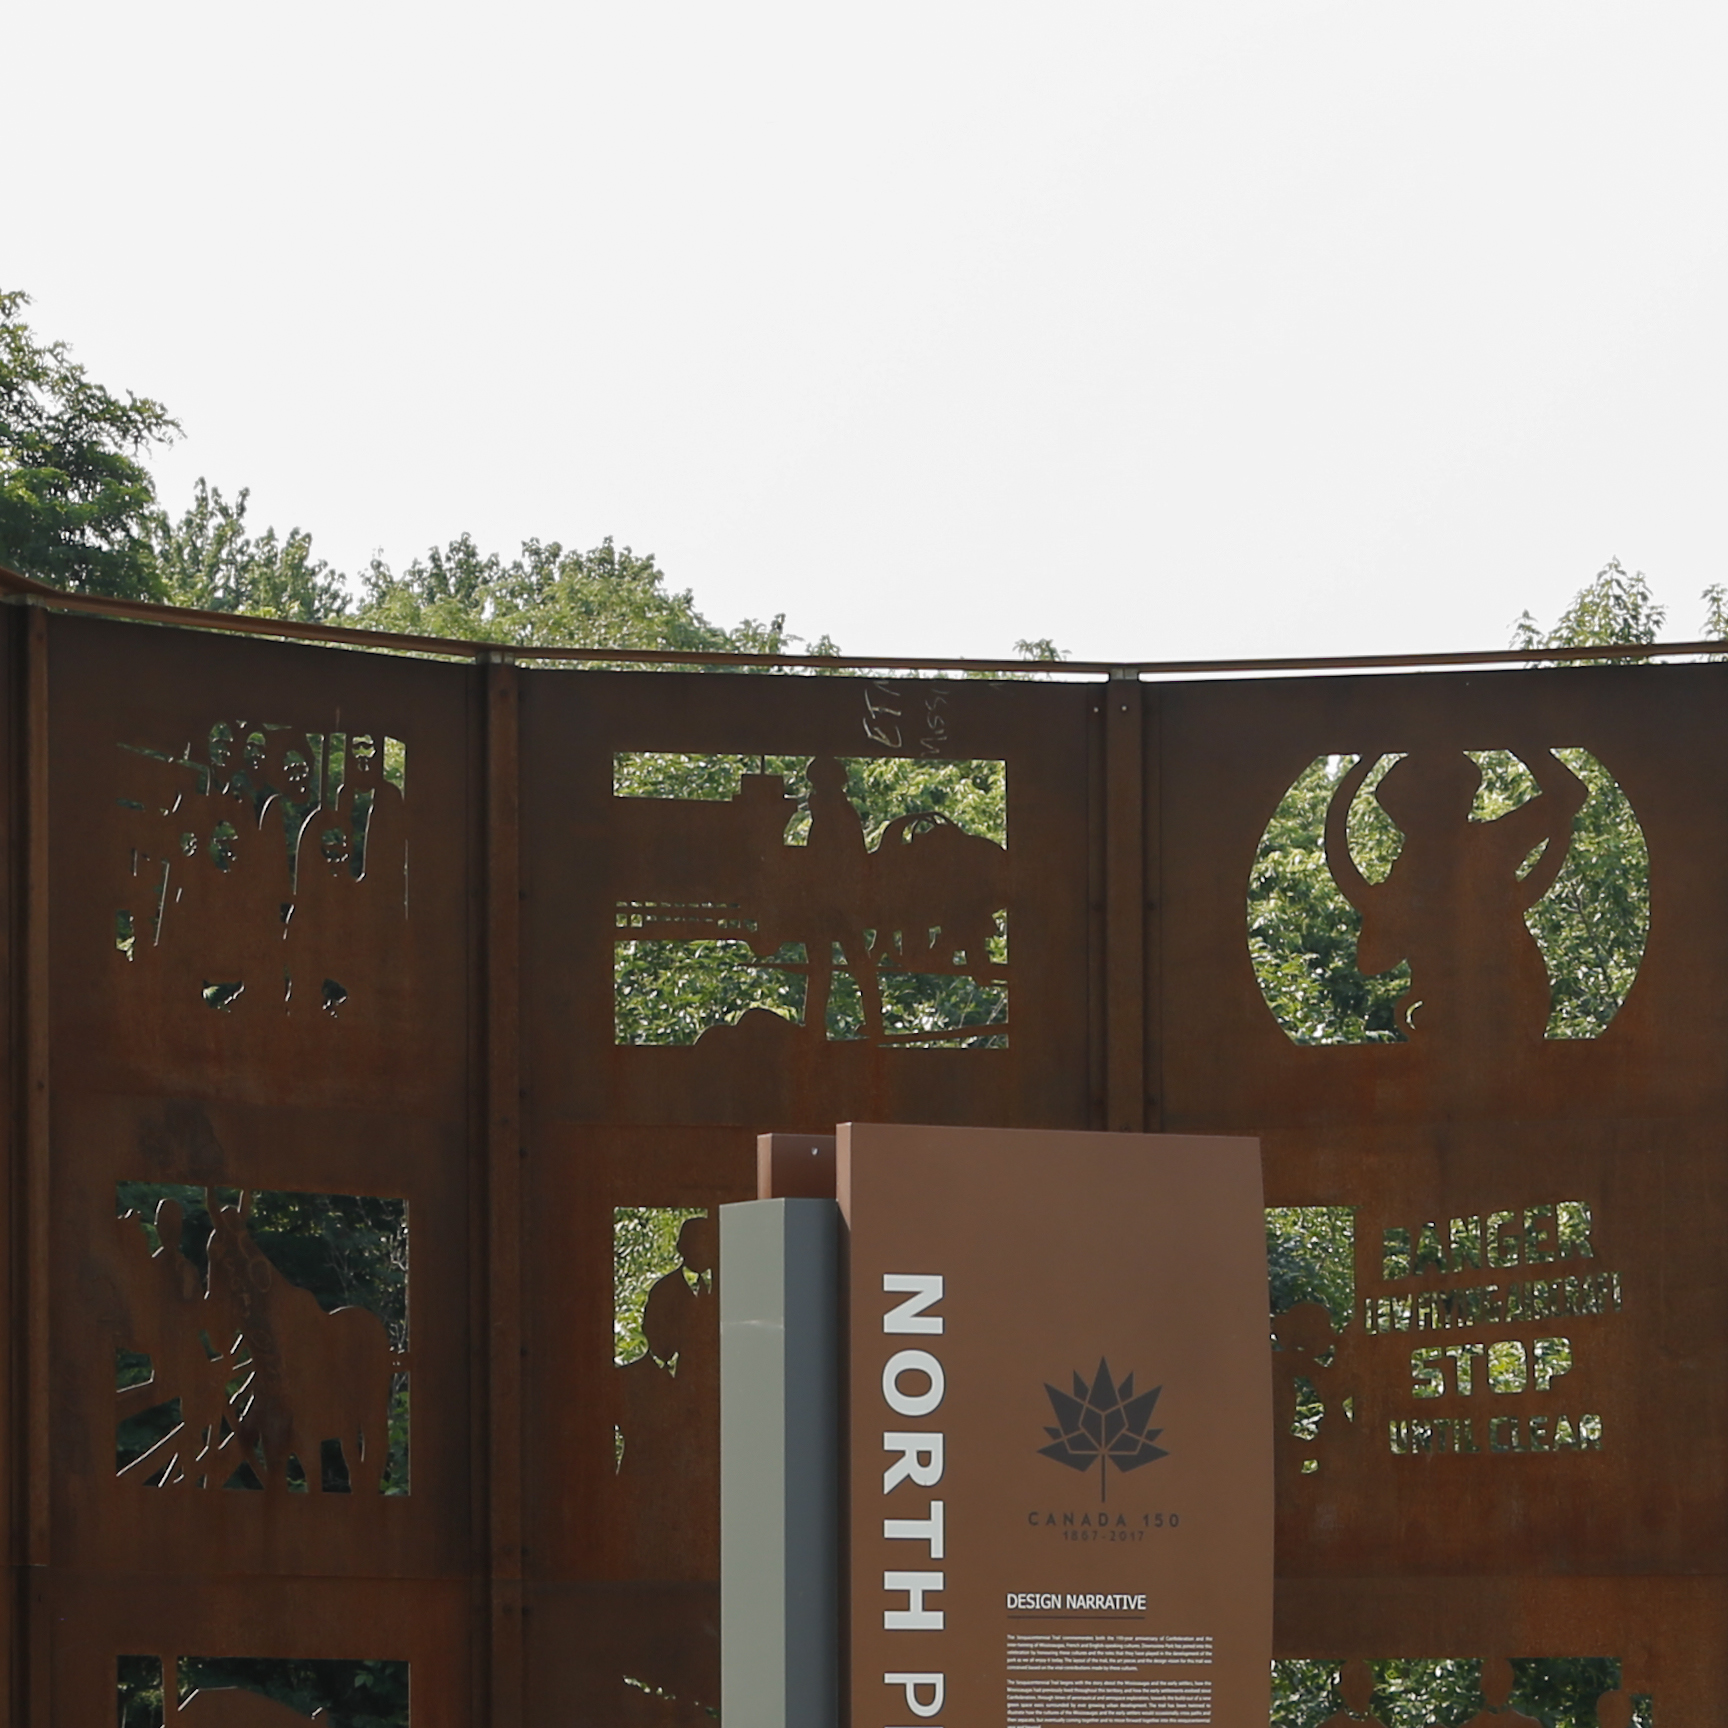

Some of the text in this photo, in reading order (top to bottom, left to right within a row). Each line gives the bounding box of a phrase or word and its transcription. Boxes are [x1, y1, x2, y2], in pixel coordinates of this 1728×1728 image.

[1382, 1200, 1594, 1281] DANGER
[1504, 1271, 1622, 1324] AIRCRAFT
[1410, 1336, 1573, 1399] STOP
[882, 1273, 945, 1630] NORTH
[1388, 1413, 1604, 1455] UNTIL CLEAR
[1028, 1511, 1180, 1528] CANADA 150
[1063, 1530, 1144, 1542] 1867-2017
[1006, 1592, 1147, 1610] DESIGN NARRATIVE
